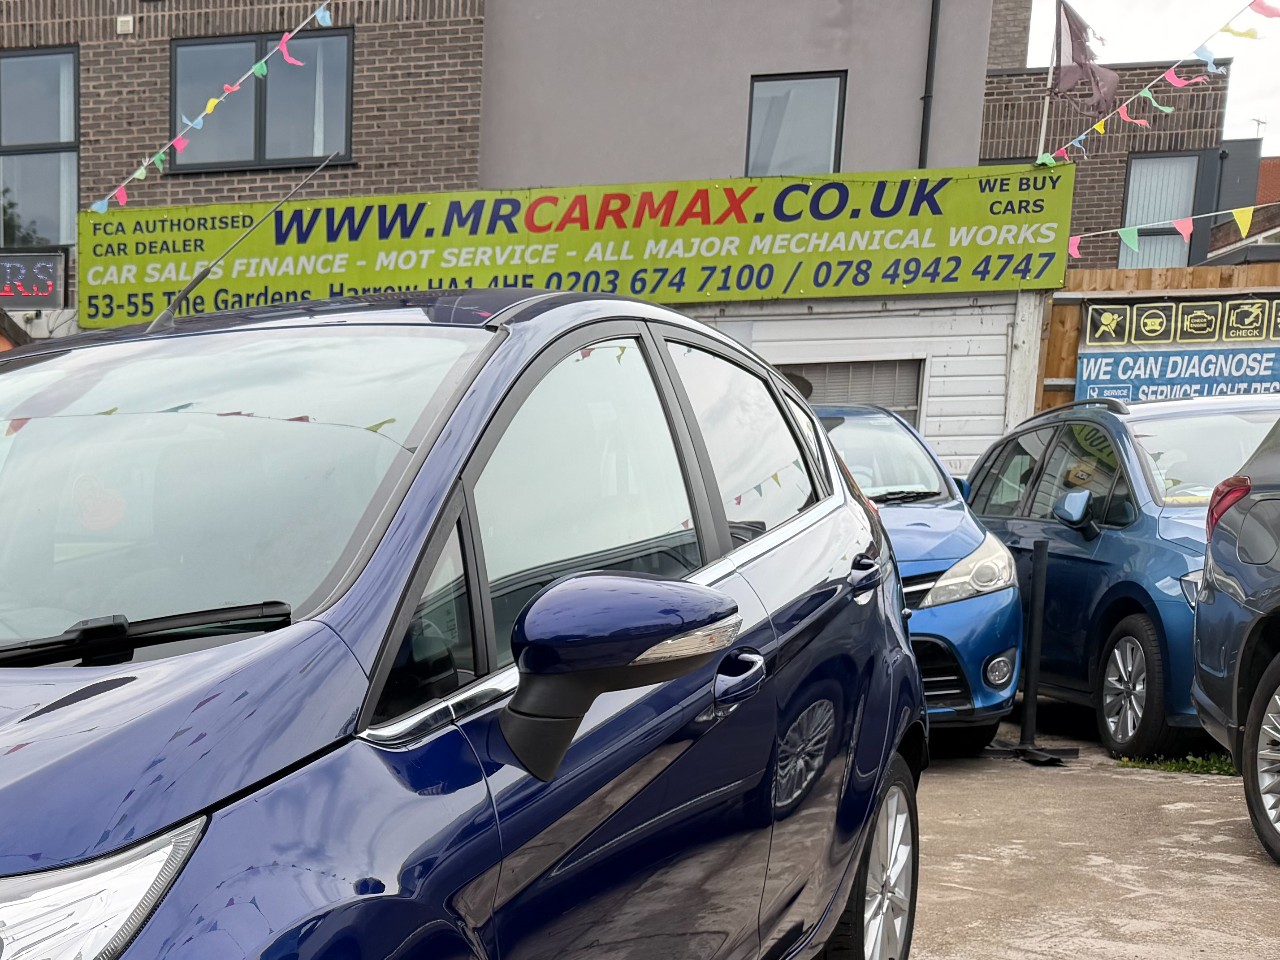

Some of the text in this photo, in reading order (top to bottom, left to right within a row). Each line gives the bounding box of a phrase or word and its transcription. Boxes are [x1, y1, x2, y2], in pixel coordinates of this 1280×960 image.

[93, 175, 1062, 246] FCA AUTHORISED WWW.MRCARMAX.CO.UK WE BUY
[989, 198, 1045, 215] CARS
[87, 264, 137, 286] CAR
[144, 259, 224, 284] SALES
[232, 254, 350, 279] FINANCE
[375, 249, 435, 272] MOT
[440, 243, 560, 268] SERVICE
[584, 240, 634, 262] ALL
[643, 234, 741, 259] MAJOR
[748, 227, 937, 254] MECHANICAL
[949, 222, 1059, 248] WORKS
[93, 239, 205, 258] CAR DEALER
[87, 292, 154, 319] 53-55
[162, 290, 205, 316] The
[545, 269, 620, 294] 0203
[630, 266, 686, 295] 674
[697, 263, 774, 293] 7100
[812, 259, 873, 288] 078
[882, 255, 962, 285] 4942
[971, 252, 1056, 281] 4747
[1229, 329, 1260, 337] CHECK
[1082, 352, 1276, 380] WE CAN DIAGNOSE
[1103, 388, 1128, 397] SERVICE
[1138, 383, 1201, 401] SERVICE
